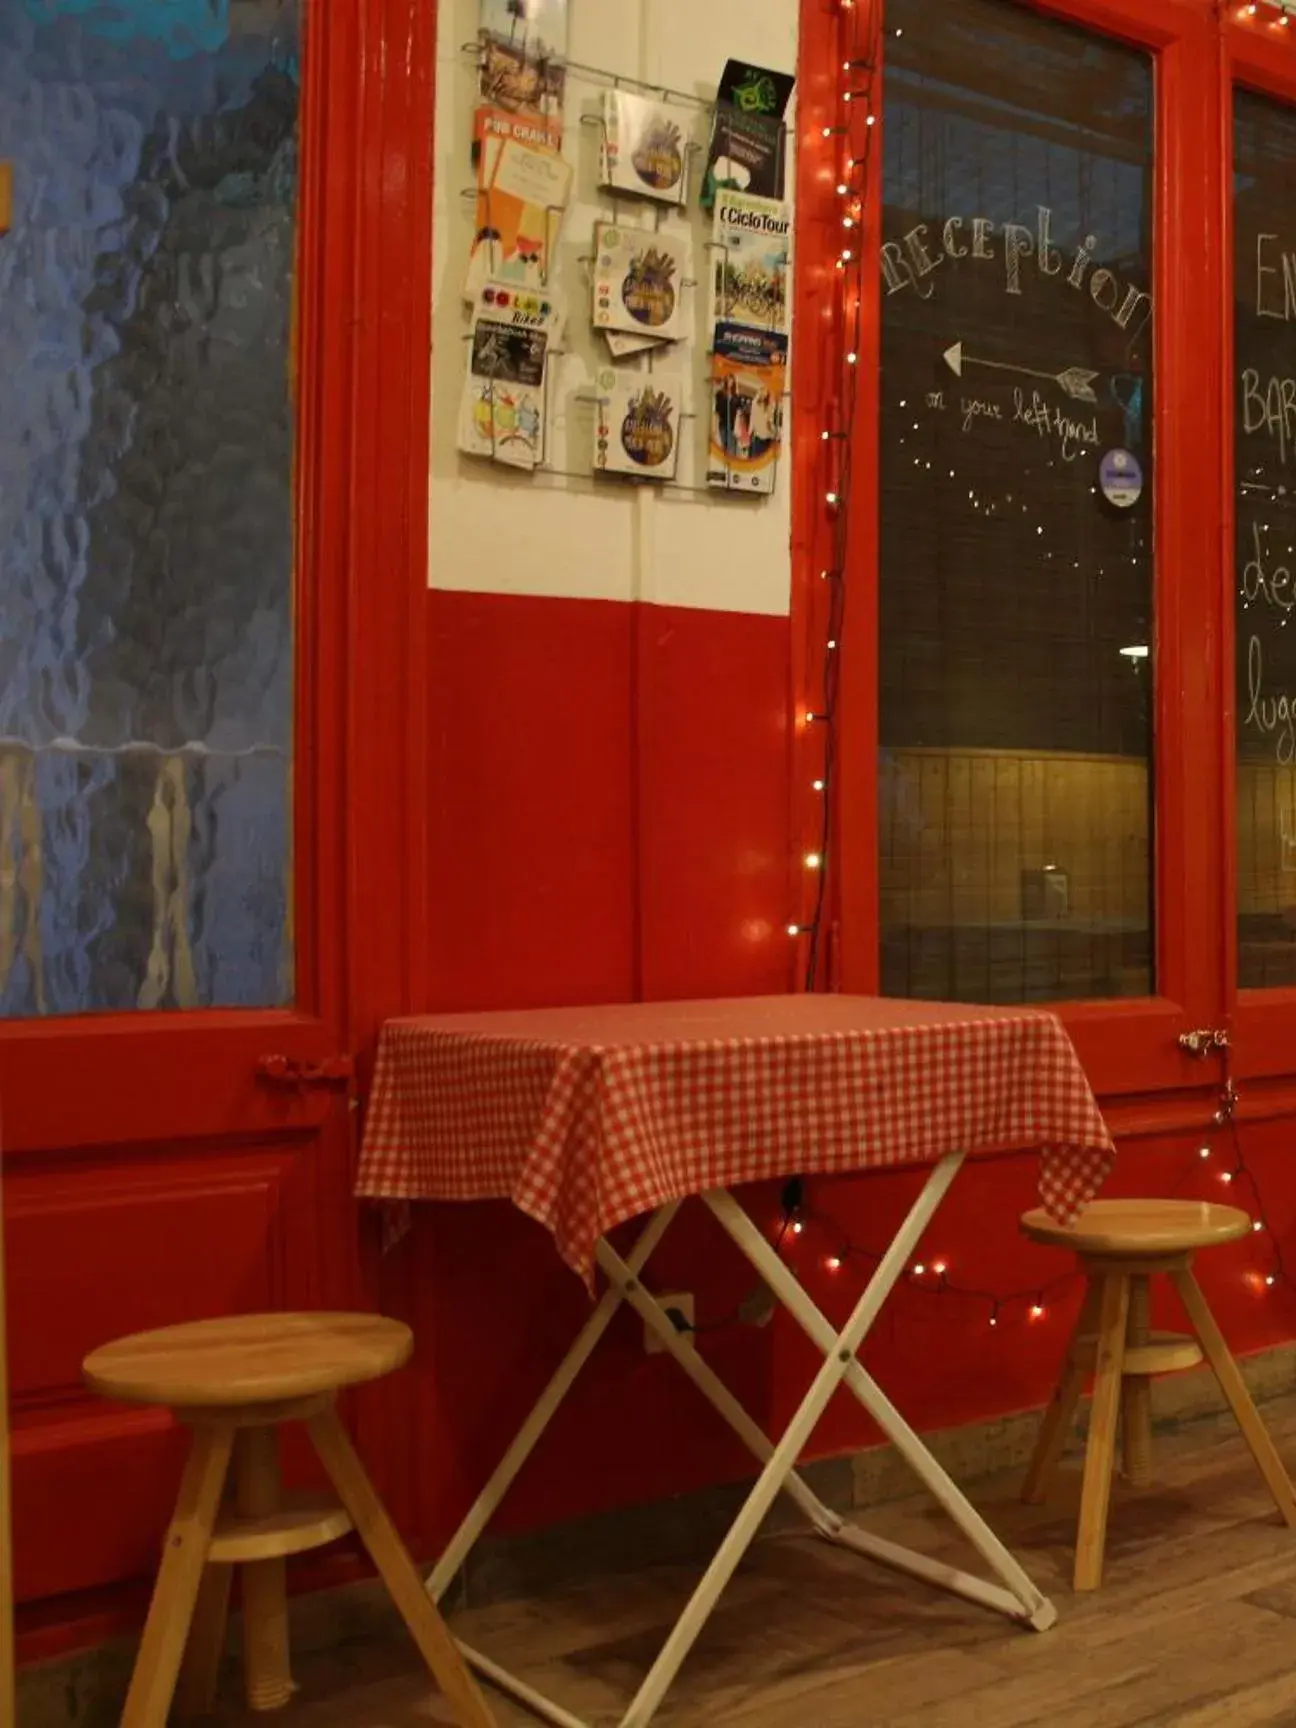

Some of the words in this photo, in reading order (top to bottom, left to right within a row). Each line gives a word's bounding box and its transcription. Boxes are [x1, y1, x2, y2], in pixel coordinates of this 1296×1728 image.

[728, 207, 789, 234] CicloTour
[960, 397, 1003, 433] your
[1013, 386, 1051, 437] left
